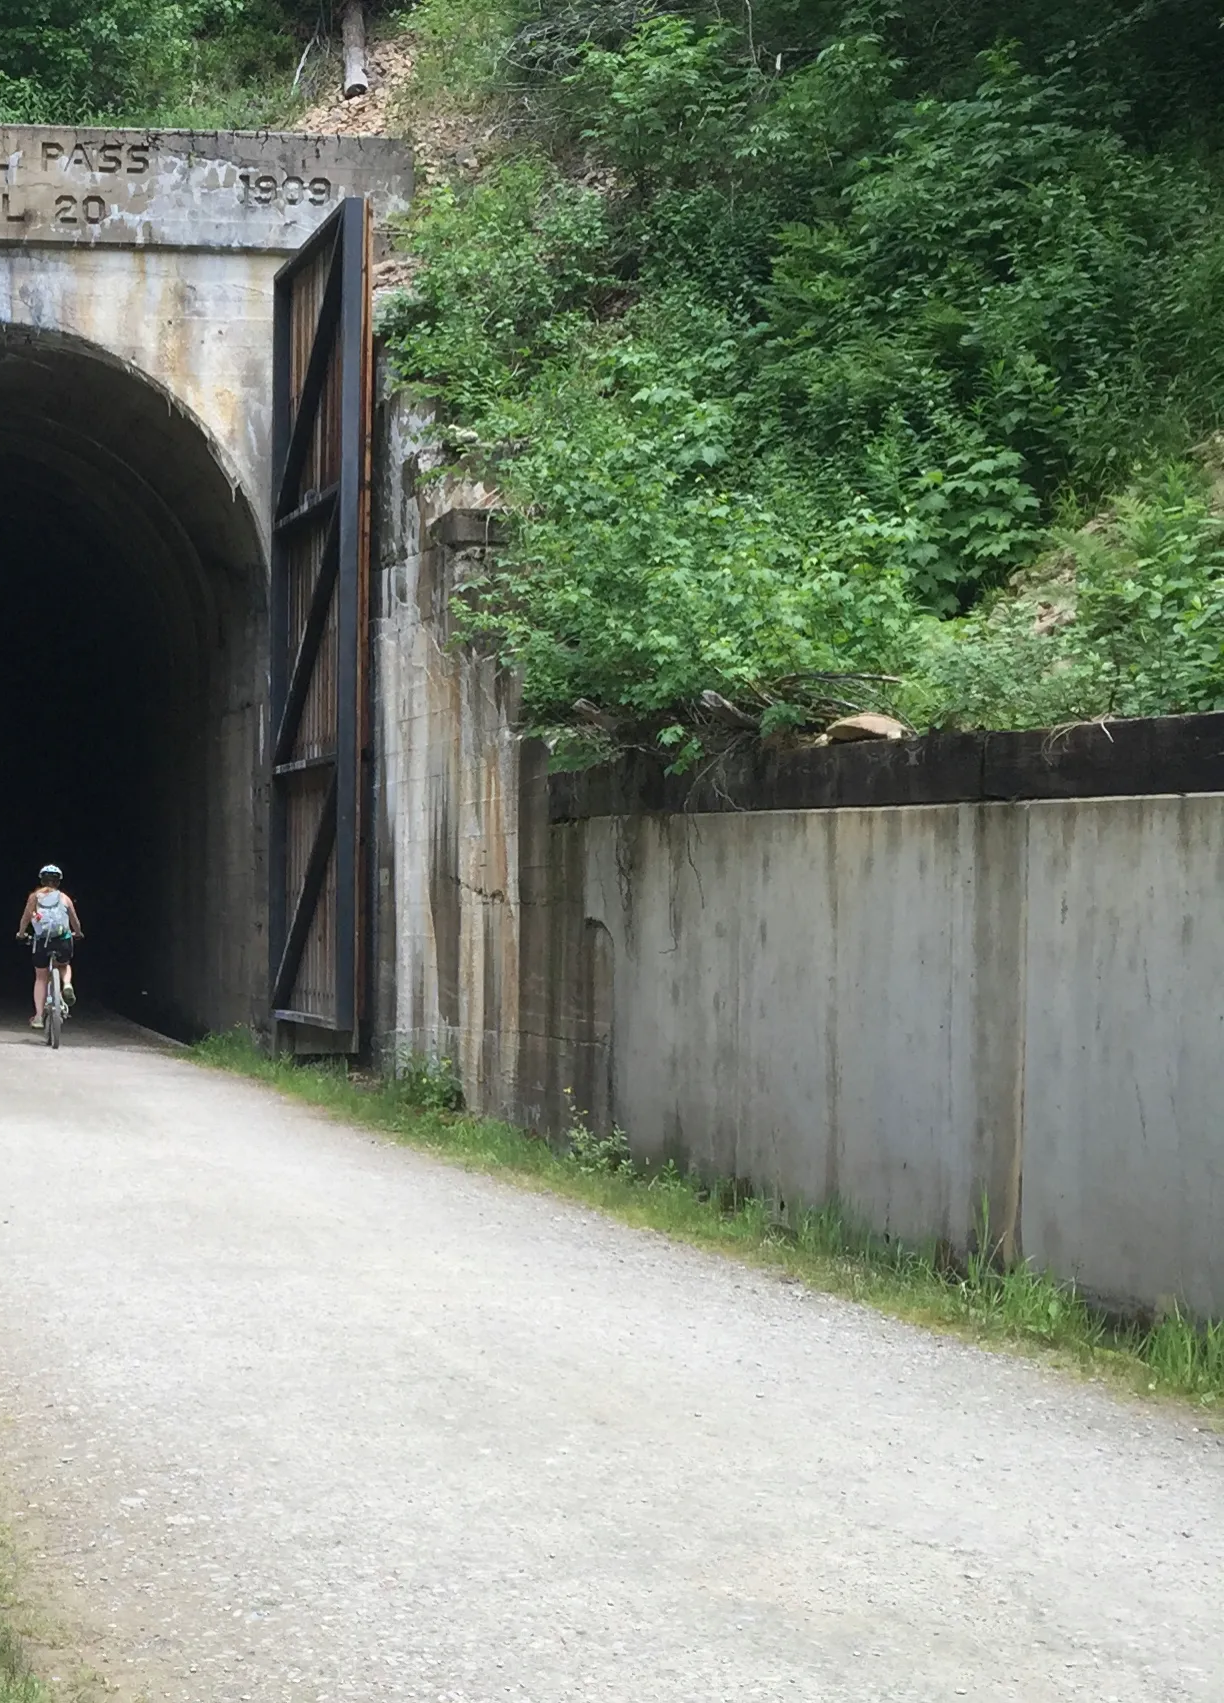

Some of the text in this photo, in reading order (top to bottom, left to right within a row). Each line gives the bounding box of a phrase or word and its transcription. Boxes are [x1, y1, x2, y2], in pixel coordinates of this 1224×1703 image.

[41, 141, 150, 175] PASS
[238, 173, 332, 207] 1909
[55, 194, 106, 225] 20
